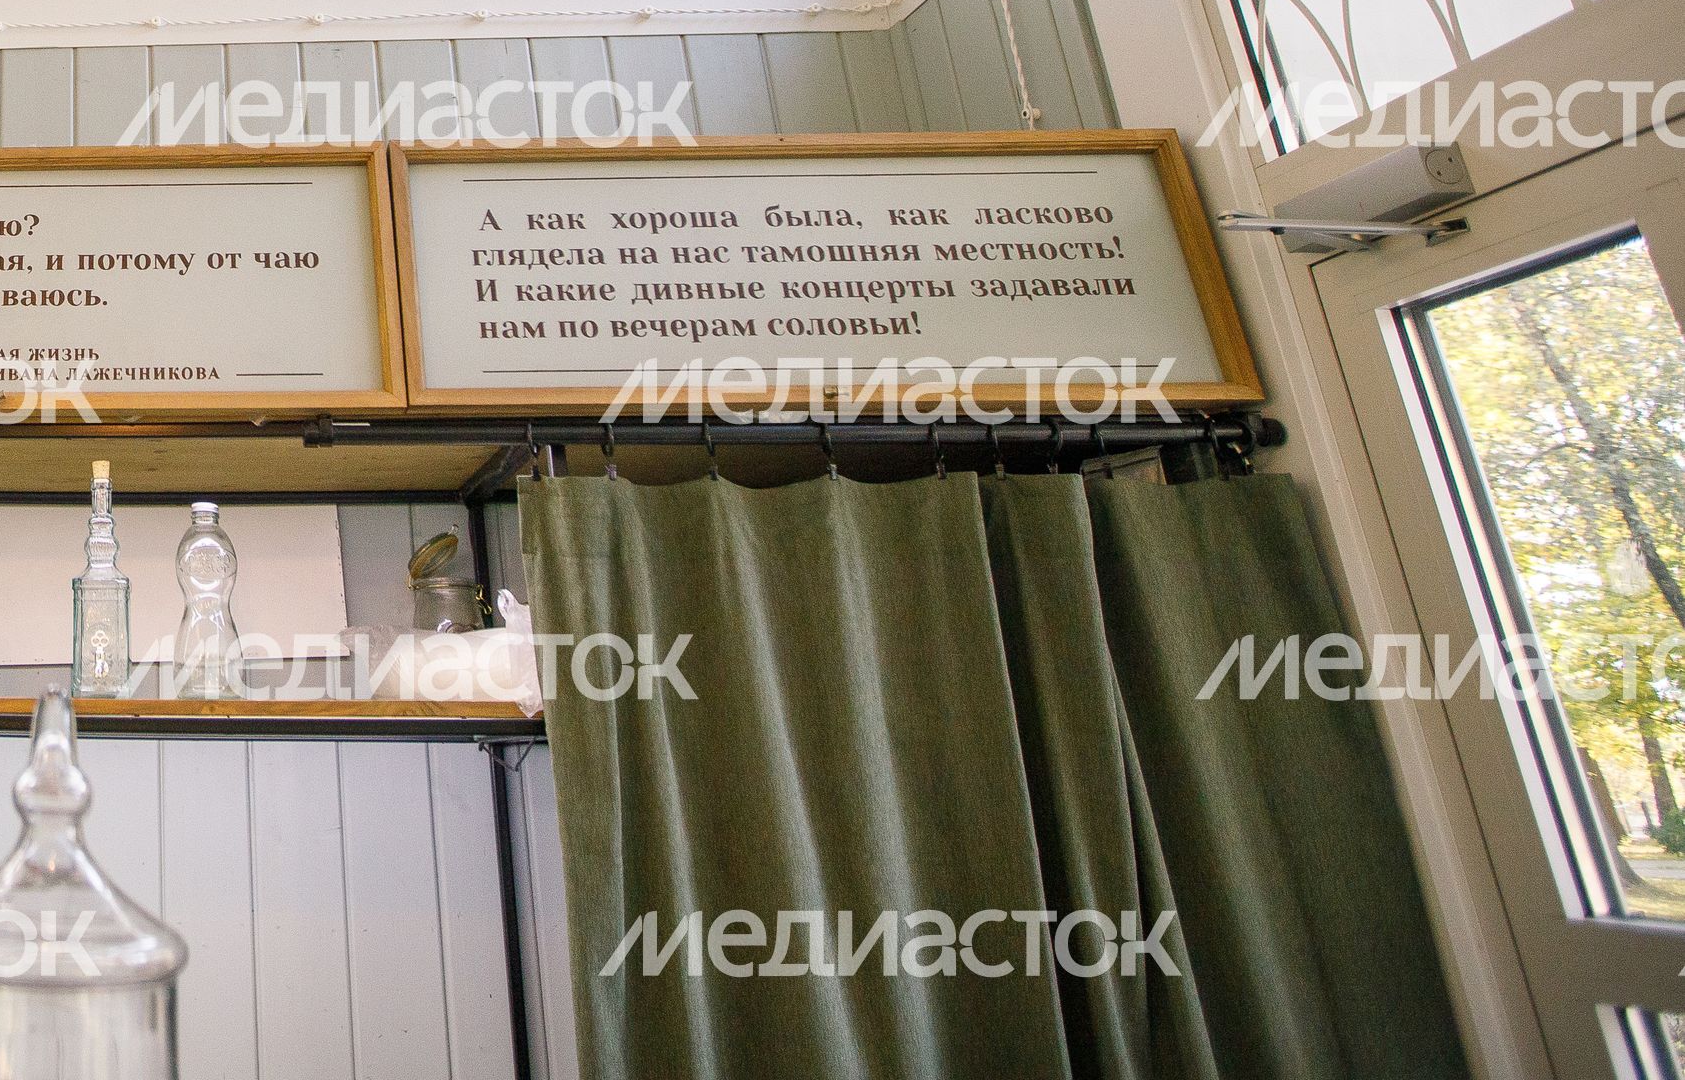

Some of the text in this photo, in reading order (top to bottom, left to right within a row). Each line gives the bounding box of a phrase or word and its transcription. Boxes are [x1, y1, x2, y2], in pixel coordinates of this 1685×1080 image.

[478, 202, 1114, 235] А как хороша была, как ласково
[45, 253, 65, 271] и
[77, 251, 196, 276] потому
[207, 251, 242, 270] от
[252, 250, 320, 269] чаю
[471, 234, 1125, 271] глядела на нас тамошняя местность!
[474, 276, 1136, 306] И какие дивные концерты задавали
[478, 309, 922, 344] нам по вечерам соловьи!
[27, 348, 101, 362] ЖИЗНЬ
[65, 366, 221, 383] ЛАЖЕЧНИКОВА
